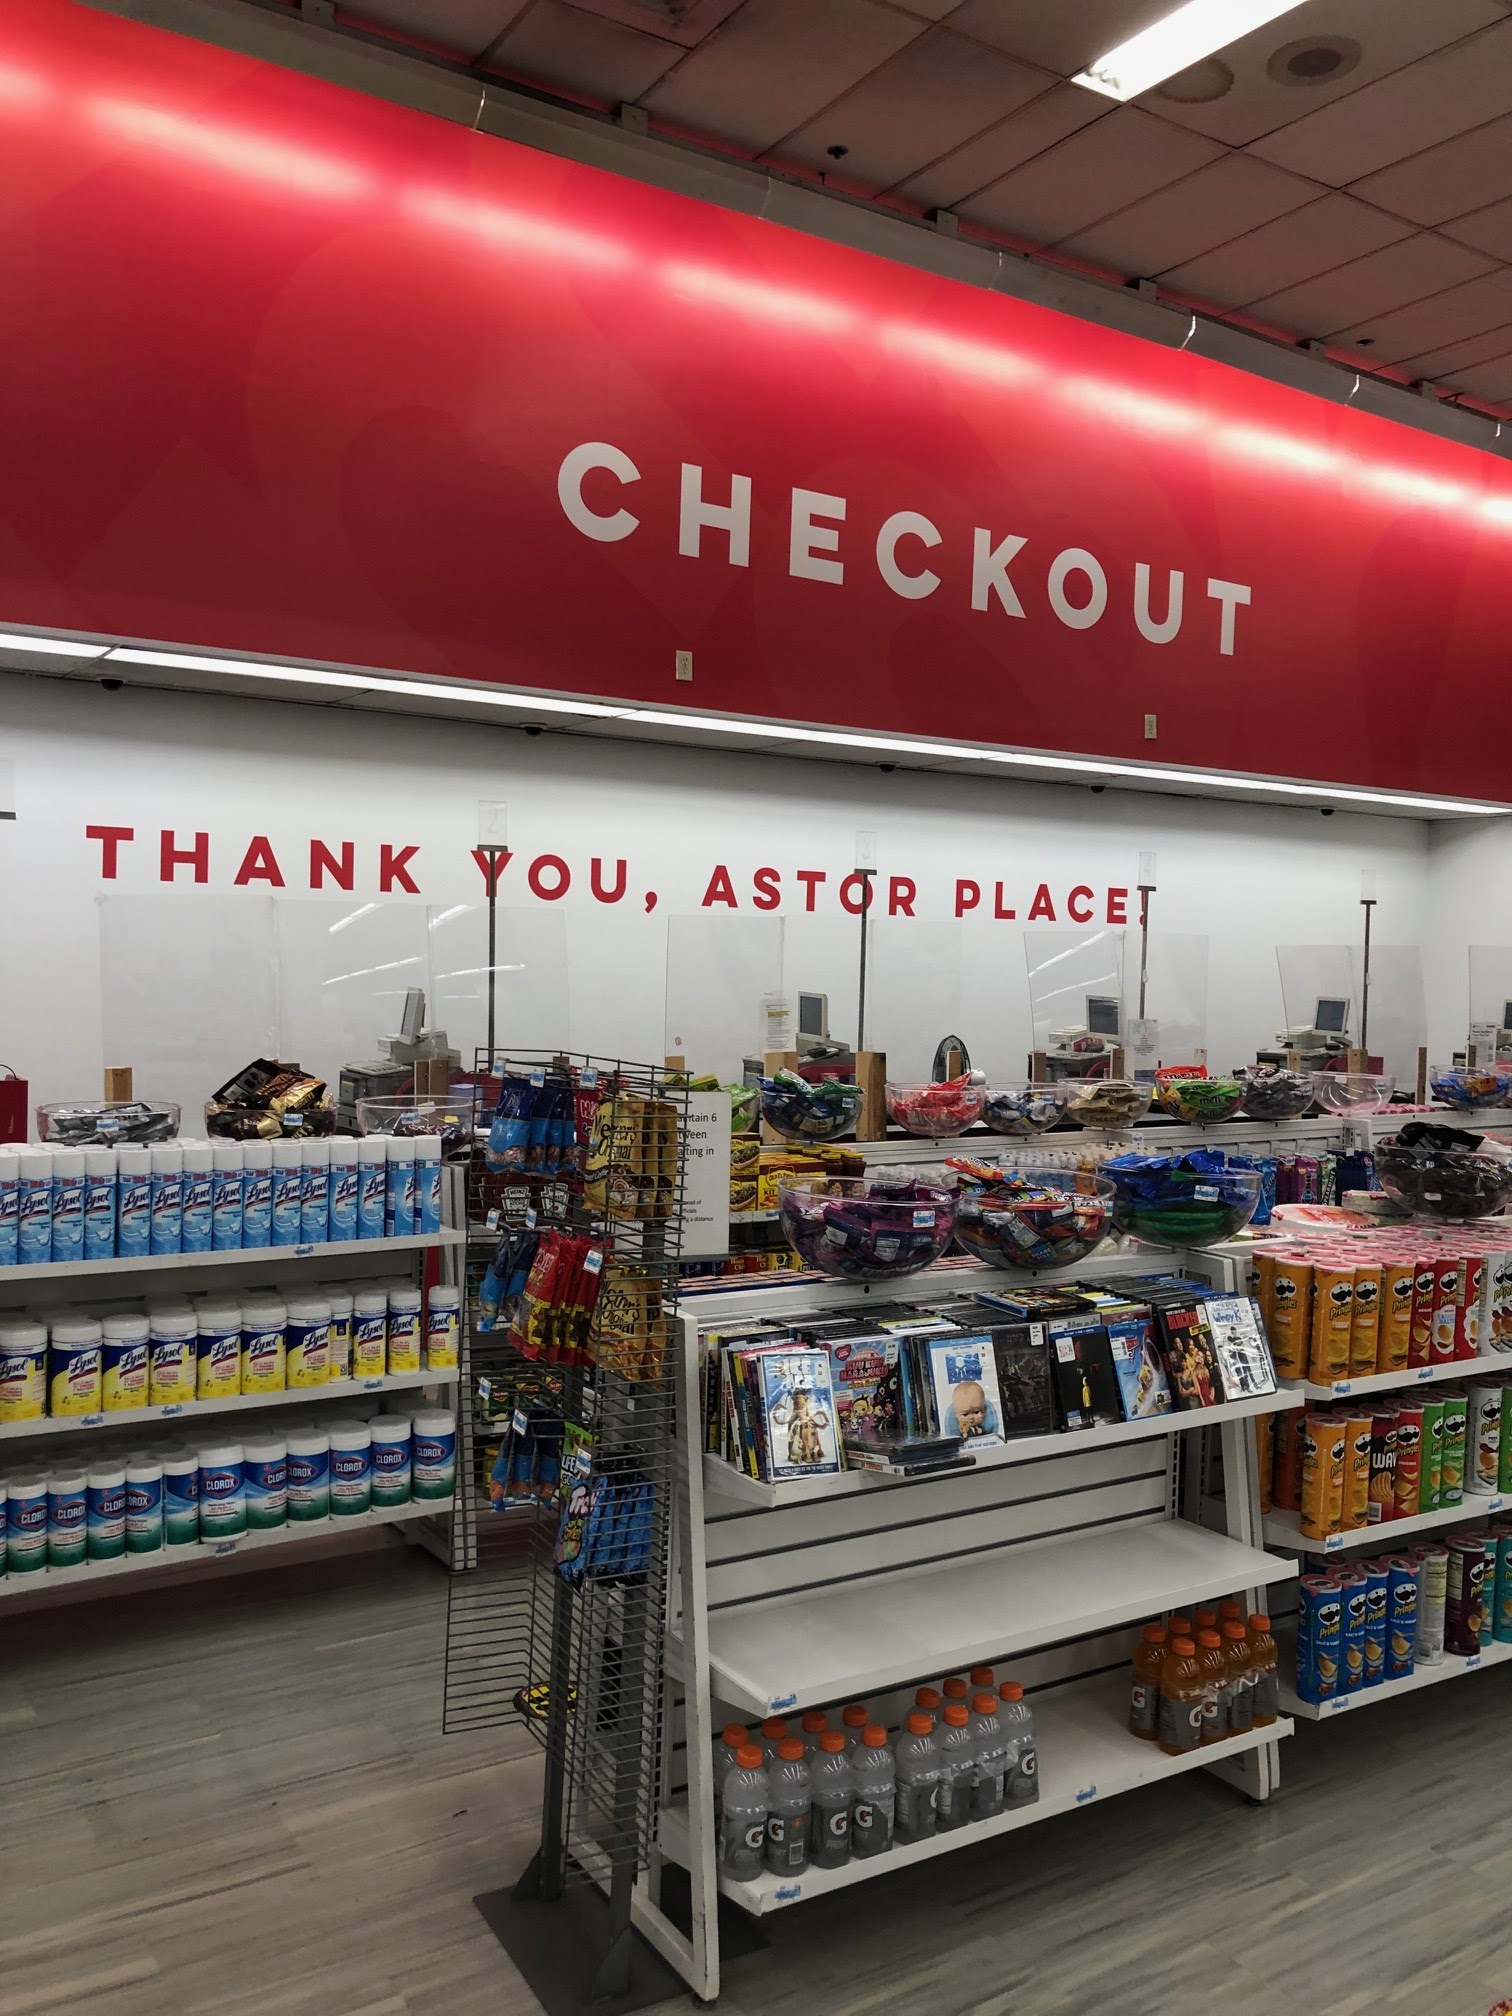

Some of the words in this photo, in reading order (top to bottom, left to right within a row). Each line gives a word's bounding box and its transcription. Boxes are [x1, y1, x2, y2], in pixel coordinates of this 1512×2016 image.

[557, 441, 1251, 657] CHECKOUT
[86, 825, 421, 894] THANK
[470, 850, 659, 914] YOU,
[701, 865, 917, 918] ASTOR
[678, 1113, 708, 1123] antain
[711, 1112, 717, 1122] 6
[678, 1130, 707, 1139] tween
[678, 1147, 703, 1158] ating
[706, 1147, 715, 1156] in
[85, 1189, 112, 1208] Lysol
[123, 1185, 150, 1209] Lysol
[154, 1183, 181, 1206] Lysol
[185, 1183, 212, 1205] Lysol
[214, 1182, 240, 1203] Lysol
[302, 1178, 328, 1198] Lysol
[20, 1190, 50, 1214] Lysol
[54, 1190, 83, 1212] Lysol
[359, 1320, 384, 1340] Lysol
[390, 1316, 415, 1334] Lysol
[429, 1313, 451, 1330] Lysol
[212, 1336, 239, 1359] Lysol
[250, 1334, 279, 1355] Lysol
[304, 1327, 329, 1349] Lysol
[70, 1350, 99, 1374] Lysol
[120, 1348, 147, 1370] Lysol
[154, 1343, 183, 1364] Lysol
[375, 1454, 402, 1465] CLOROX
[416, 1446, 442, 1457] CLOROX
[335, 1462, 363, 1473] CLOROX
[206, 1478, 235, 1490] CLOROX
[1131, 1686, 1146, 1708] G
[1022, 1751, 1035, 1775] G
[829, 1810, 848, 1835] G
[855, 1805, 873, 1828] G
[745, 1824, 764, 1848] G
[768, 1818, 785, 1841] G
